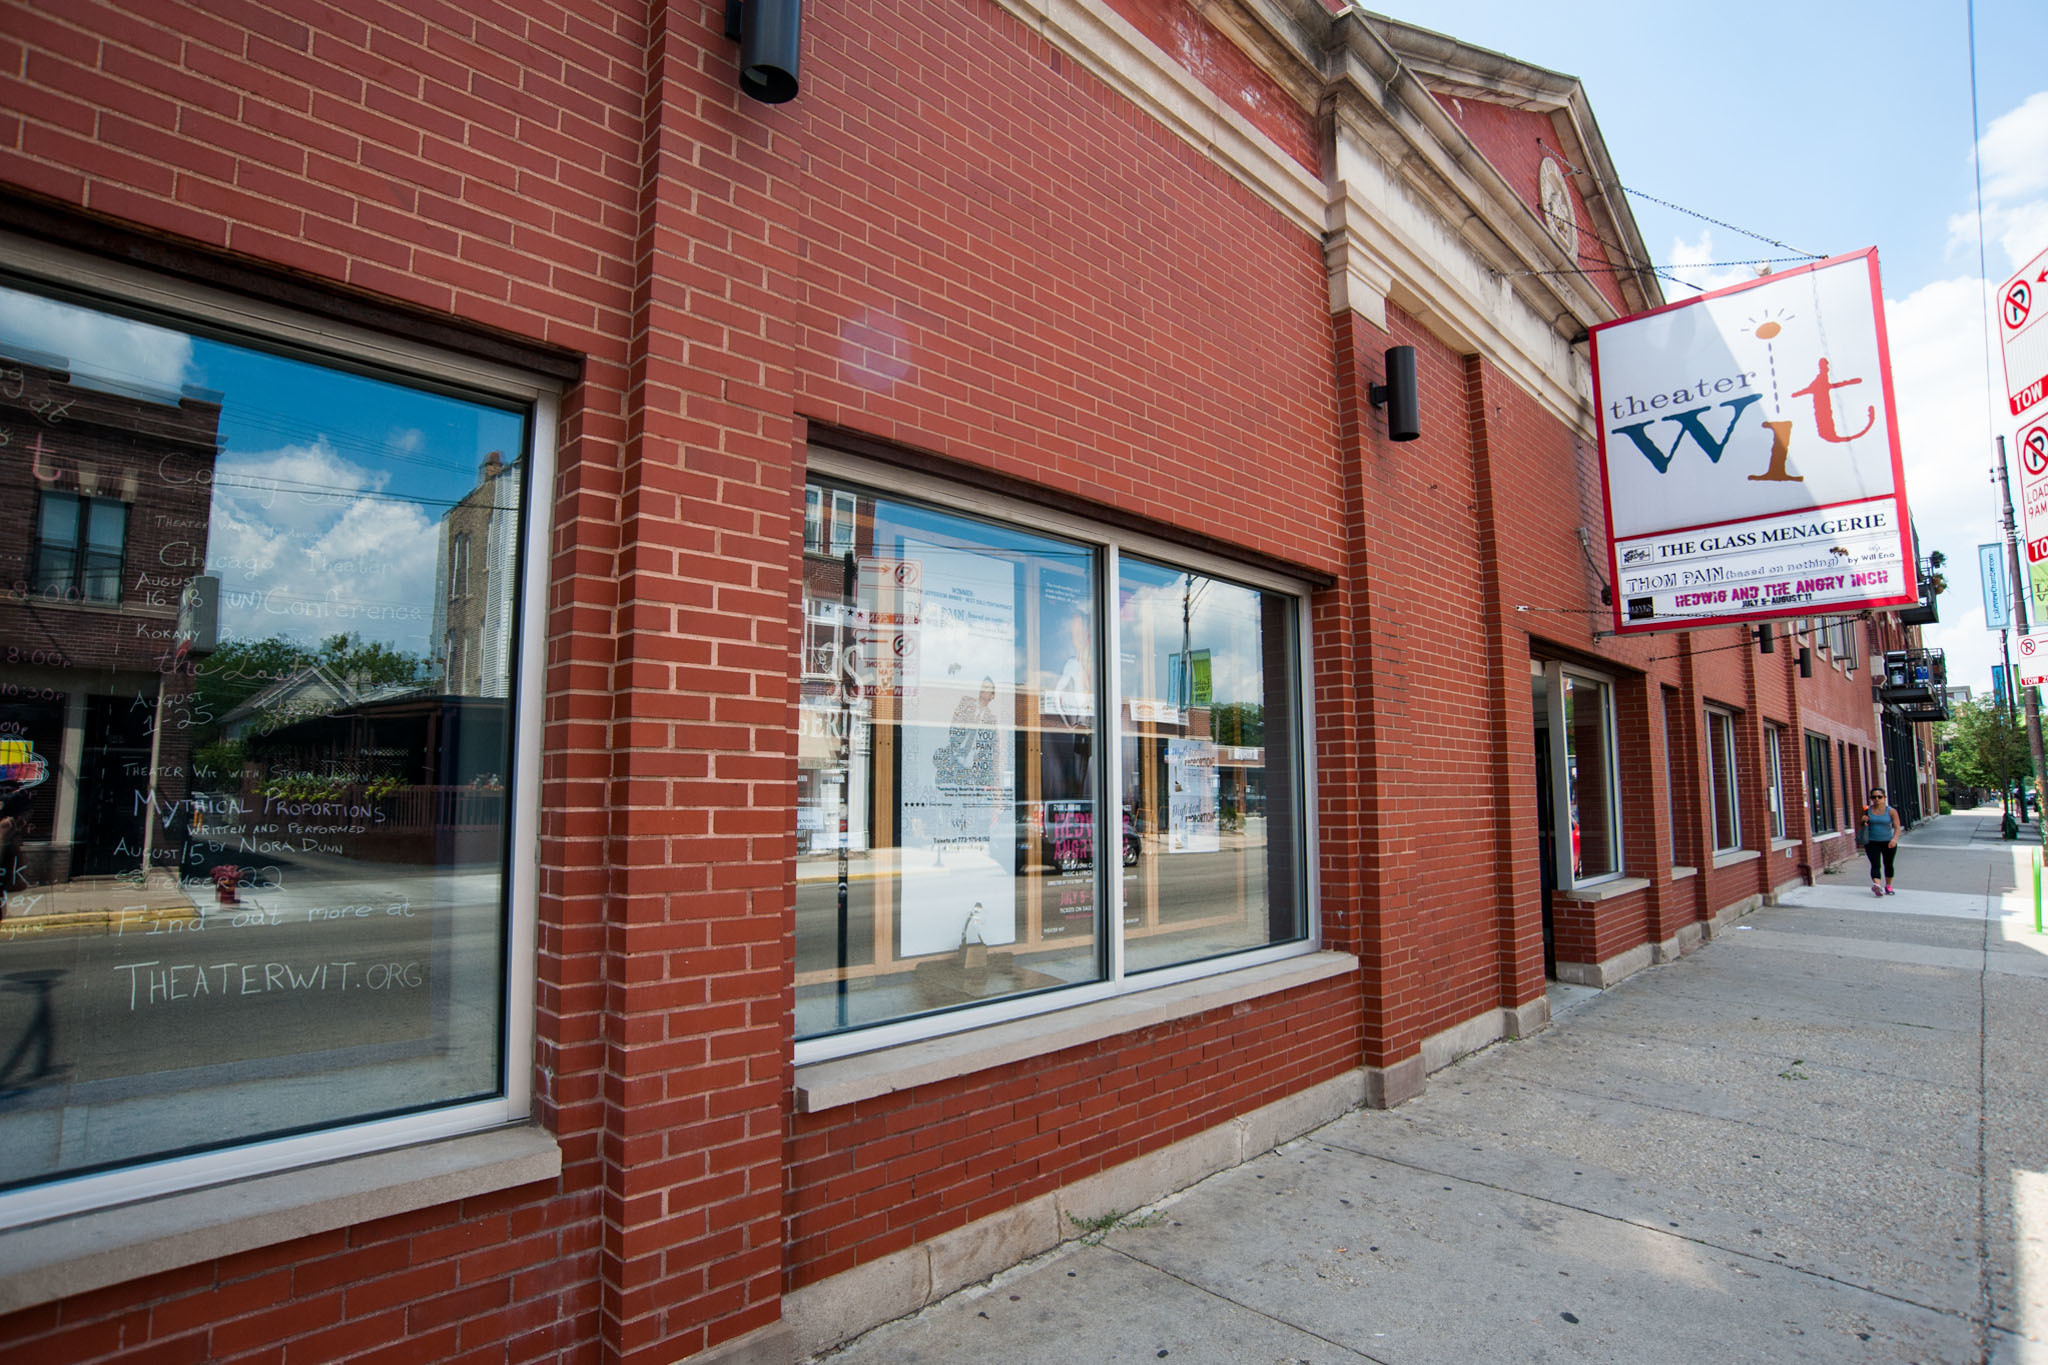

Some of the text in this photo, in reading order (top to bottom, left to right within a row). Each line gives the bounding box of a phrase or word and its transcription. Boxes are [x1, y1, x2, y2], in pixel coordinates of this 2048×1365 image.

[1610, 370, 1757, 420] theater
[2013, 380, 2042, 412] TOW
[1611, 356, 1876, 483] wit
[1658, 541, 1696, 558] THE
[1700, 532, 1757, 553] GLASS
[1761, 513, 1887, 545] MENAGERIE
[2031, 538, 2048, 560] TO
[1626, 551, 1896, 594] THOM PAIN (based on nothing) by Will Eno
[1731, 586, 1760, 602] AND
[1763, 582, 1790, 598] THE
[1796, 575, 1845, 595] ANGRY
[1742, 599, 1759, 608] JULY
[1771, 594, 1803, 604] AUGUST
[2023, 676, 2038, 685] TOW
[114, 961, 423, 1011] THEATERWIT.ORG
